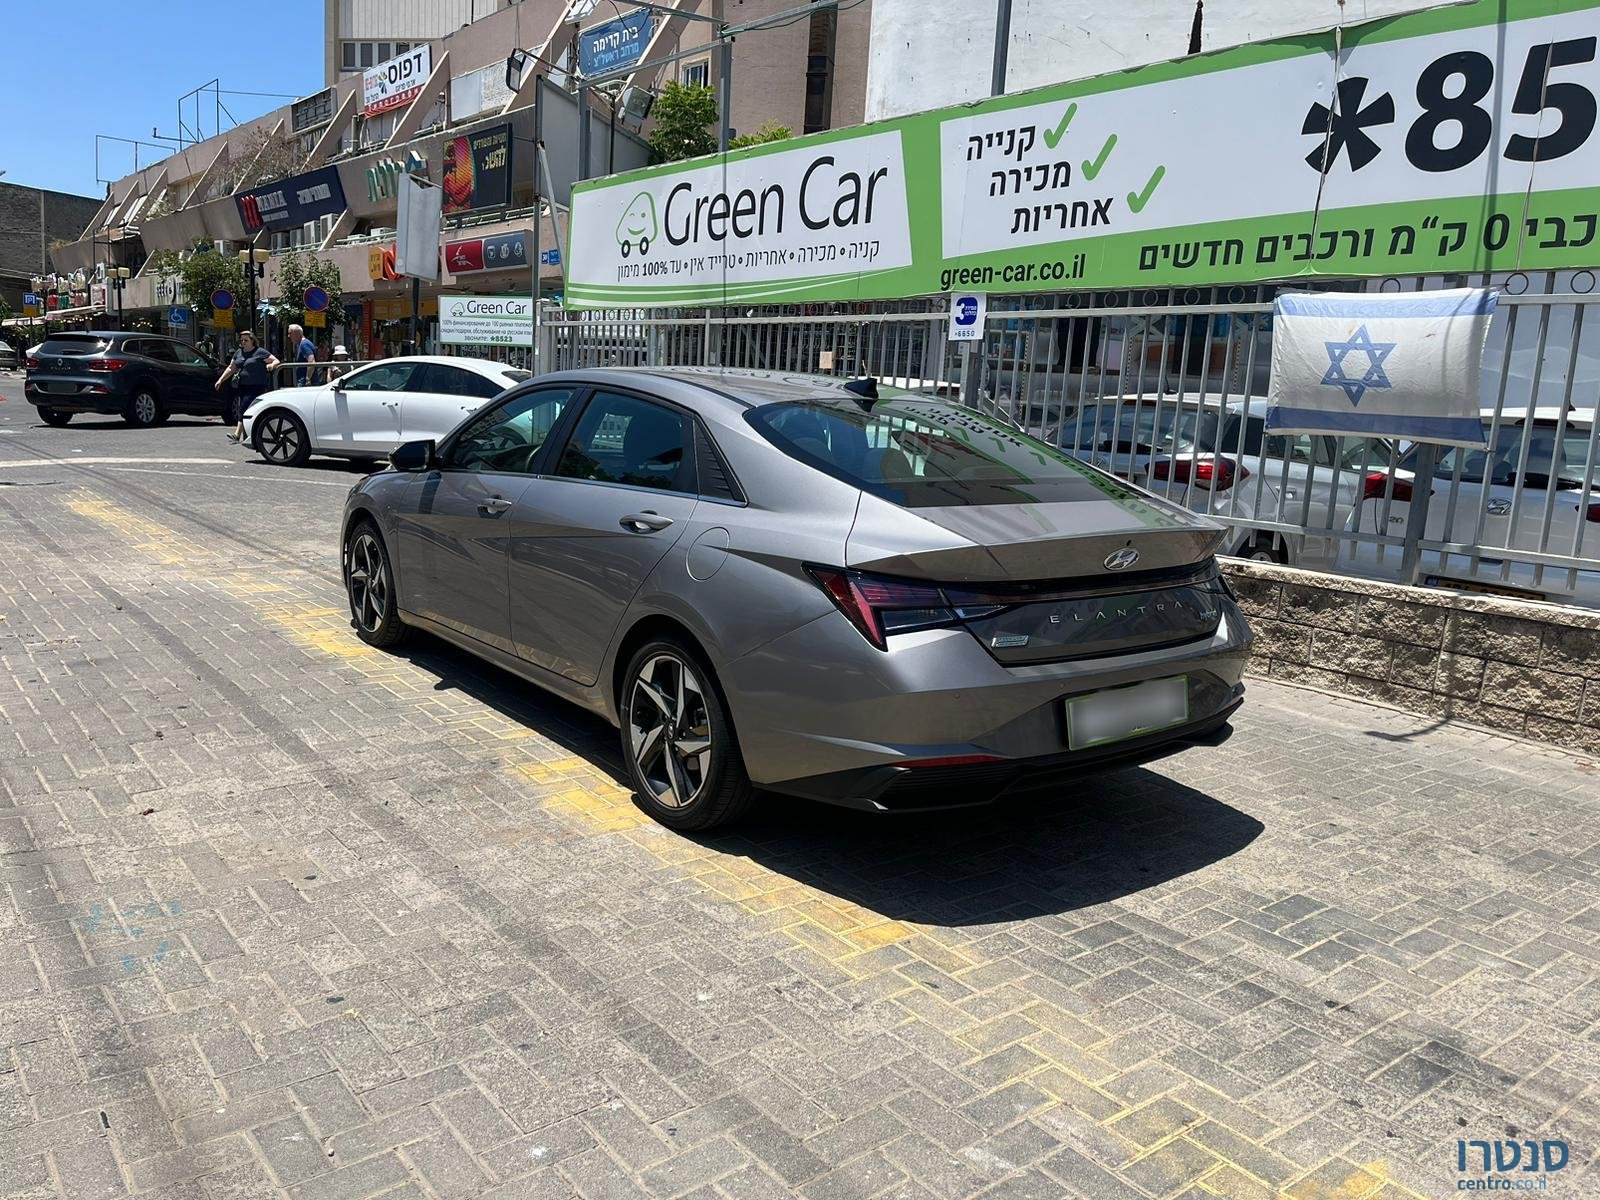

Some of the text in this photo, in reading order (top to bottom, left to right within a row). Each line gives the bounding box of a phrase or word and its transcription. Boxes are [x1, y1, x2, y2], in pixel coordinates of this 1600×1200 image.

[388, 53, 422, 85] דפוס
[966, 125, 1036, 162] קנייה
[989, 159, 1071, 197] מכירה
[665, 156, 888, 246] Green Car
[1010, 197, 1113, 234] אחריות
[1256, 229, 1374, 264] ורכבים
[1483, 213, 1510, 251] 0
[617, 240, 880, 282] קניה מכירה אחריות טרייד אין עד 100% מימון
[940, 253, 1086, 290] green-car.co.il
[1139, 239, 1244, 270] חדשים
[467, 300, 527, 315] Green Car
[1050, 600, 1183, 623] ELANTRA
